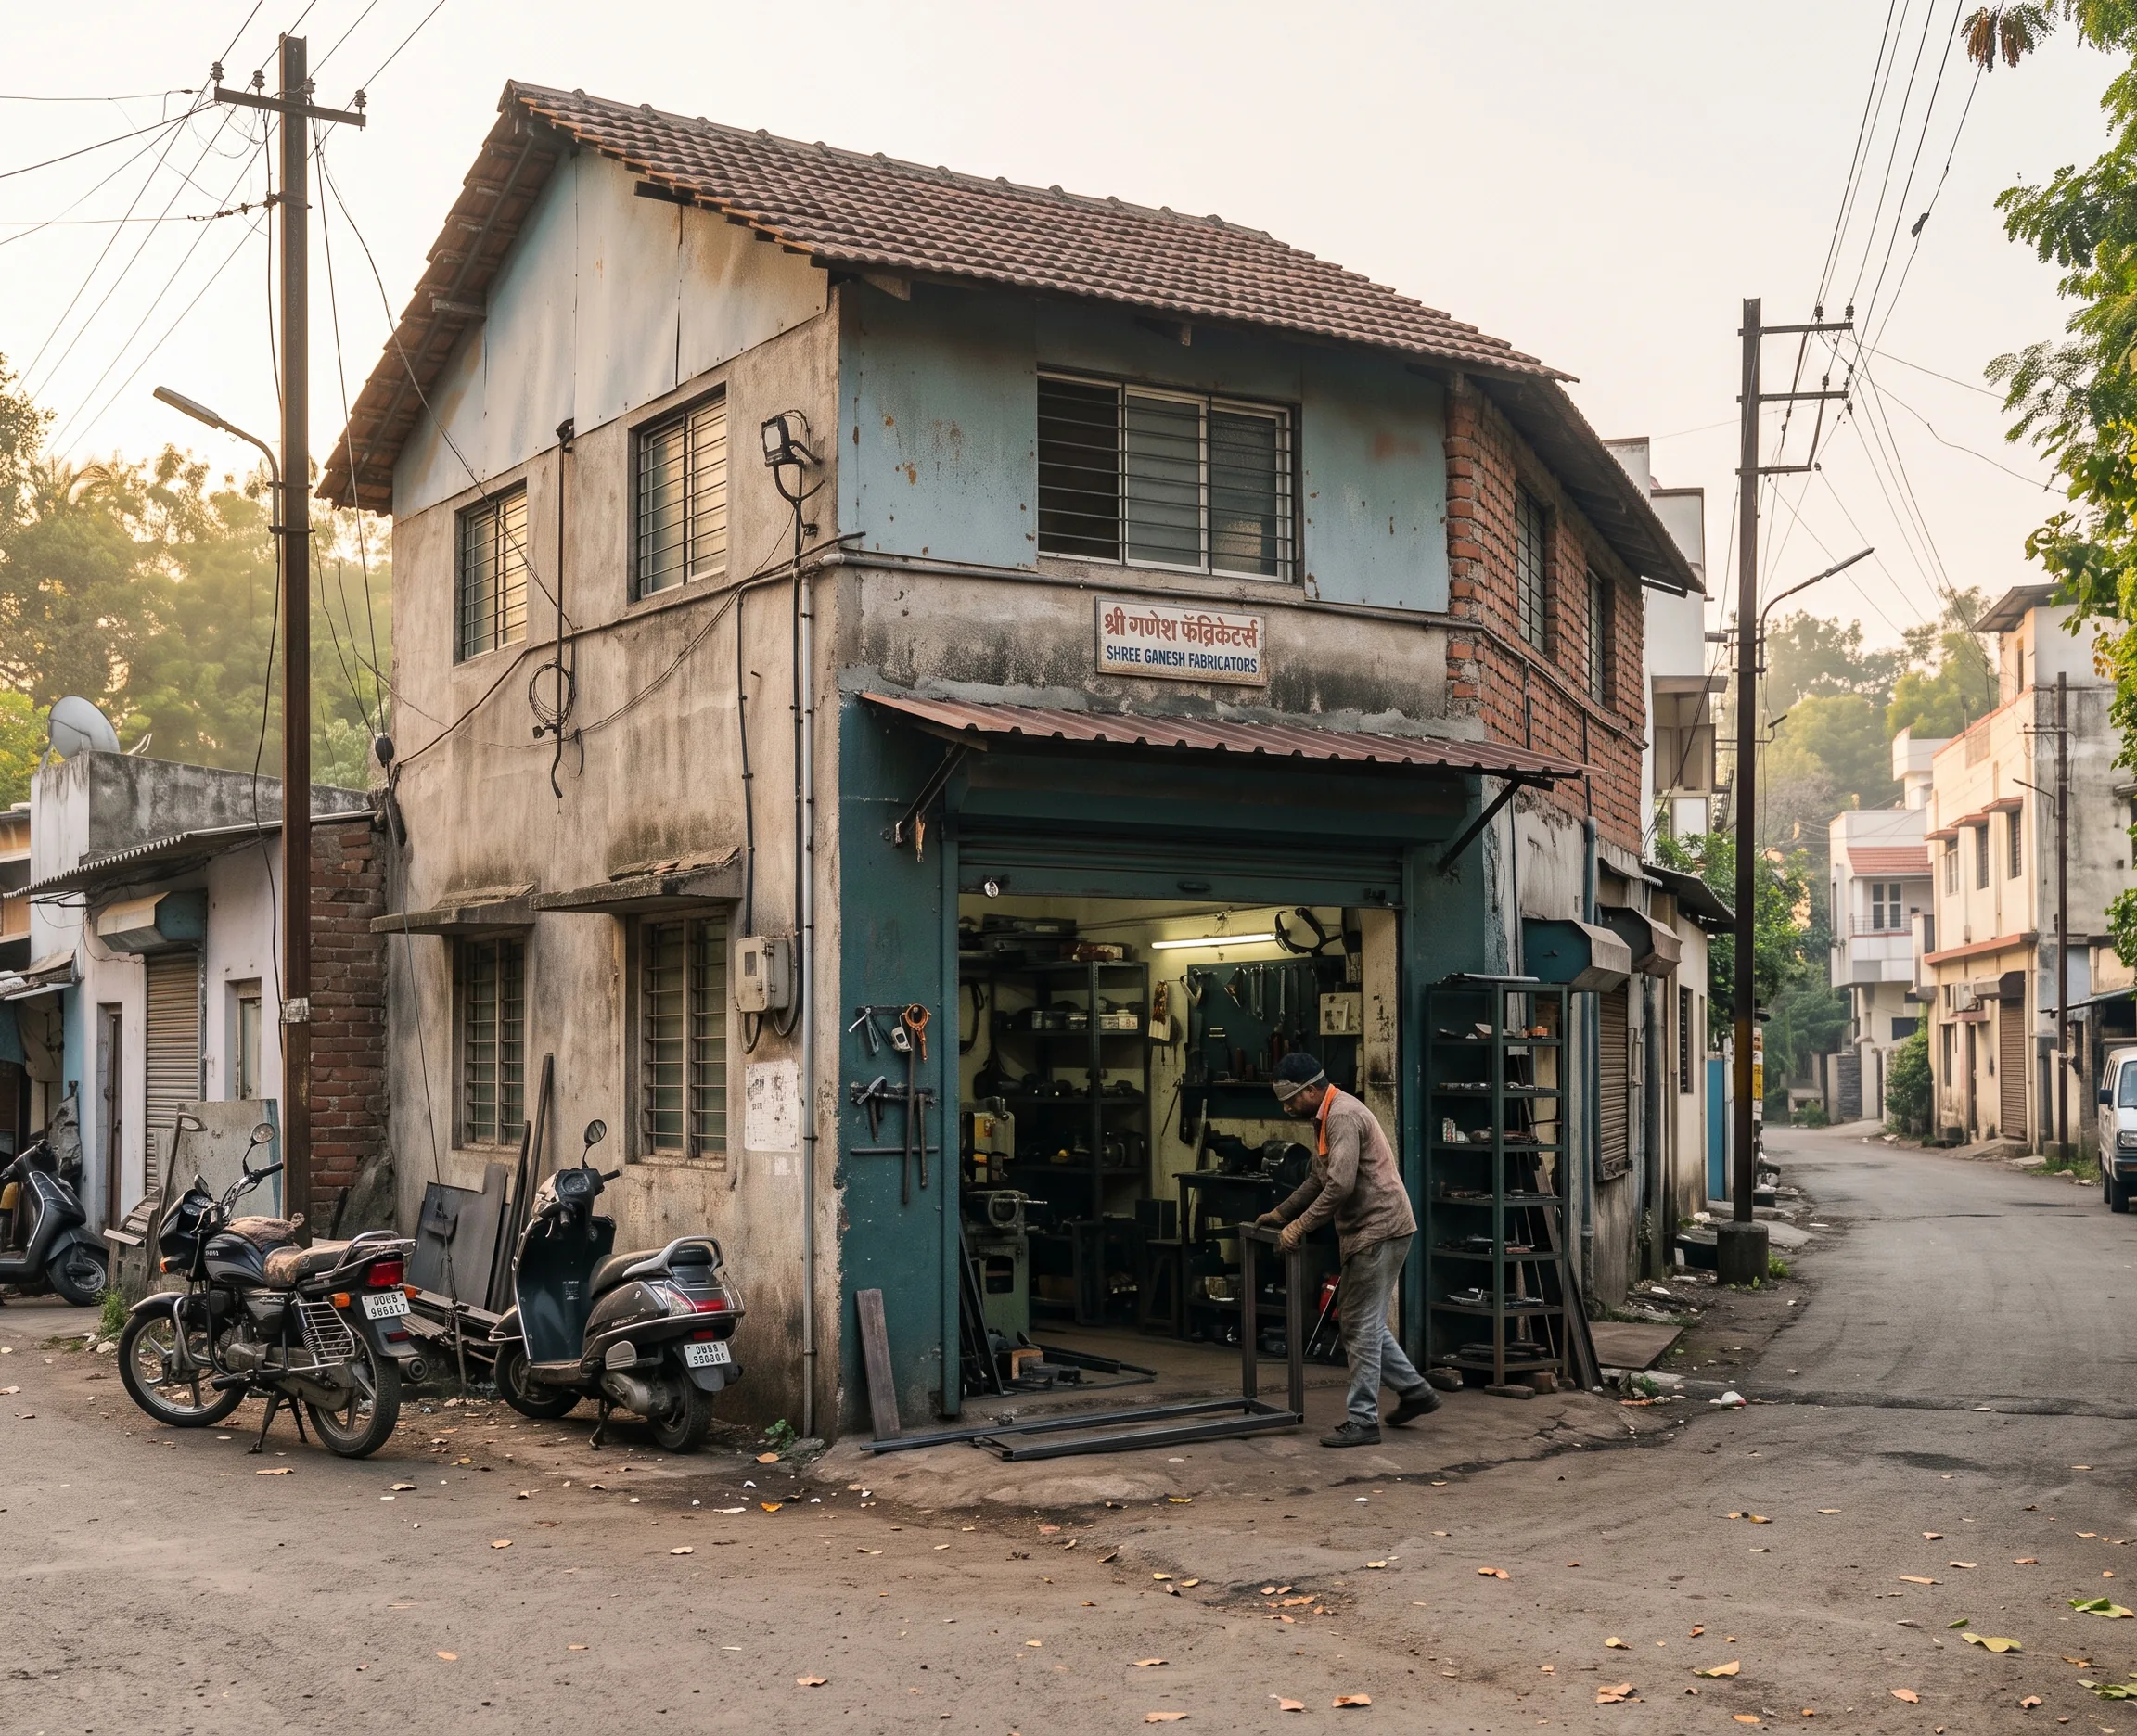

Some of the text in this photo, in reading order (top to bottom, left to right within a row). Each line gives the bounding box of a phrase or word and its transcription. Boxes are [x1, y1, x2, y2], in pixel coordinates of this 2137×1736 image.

[1105, 606, 1126, 637] श्री
[1129, 609, 1178, 642] गणेश
[1107, 645, 1258, 674] SHREE GANESH FABRICATORS
